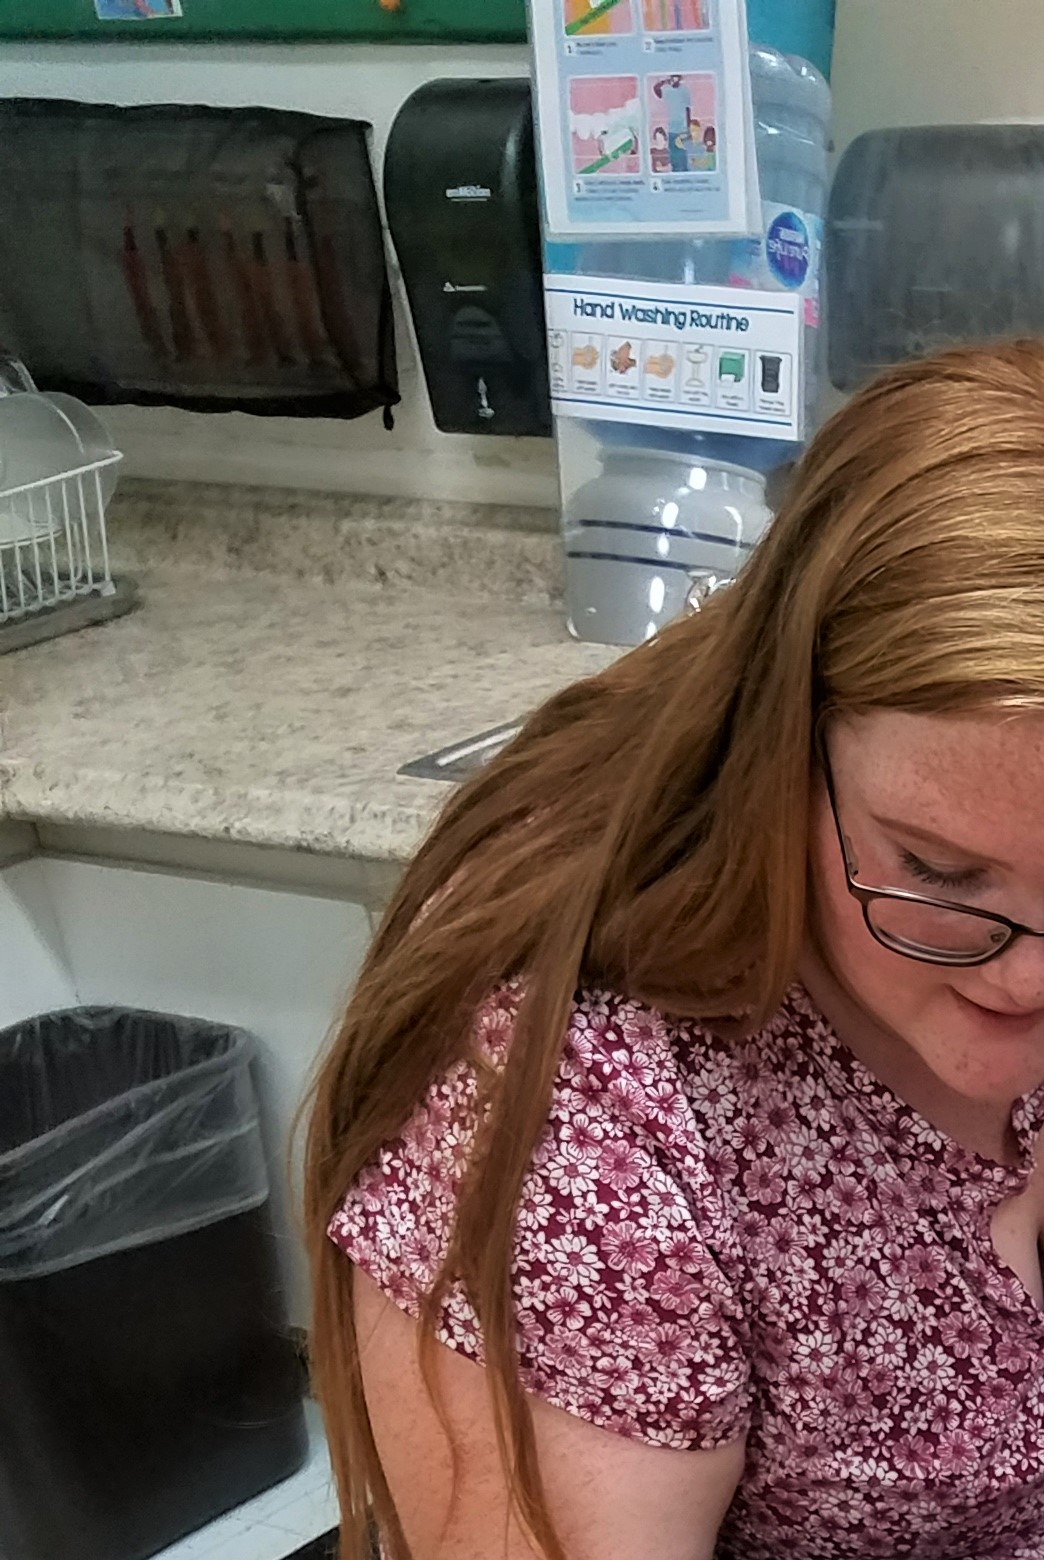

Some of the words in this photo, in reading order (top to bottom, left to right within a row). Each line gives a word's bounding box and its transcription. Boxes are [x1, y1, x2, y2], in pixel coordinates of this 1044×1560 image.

[573, 298, 615, 319] Hand
[618, 303, 687, 330] Washing
[689, 309, 750, 332] Routine
